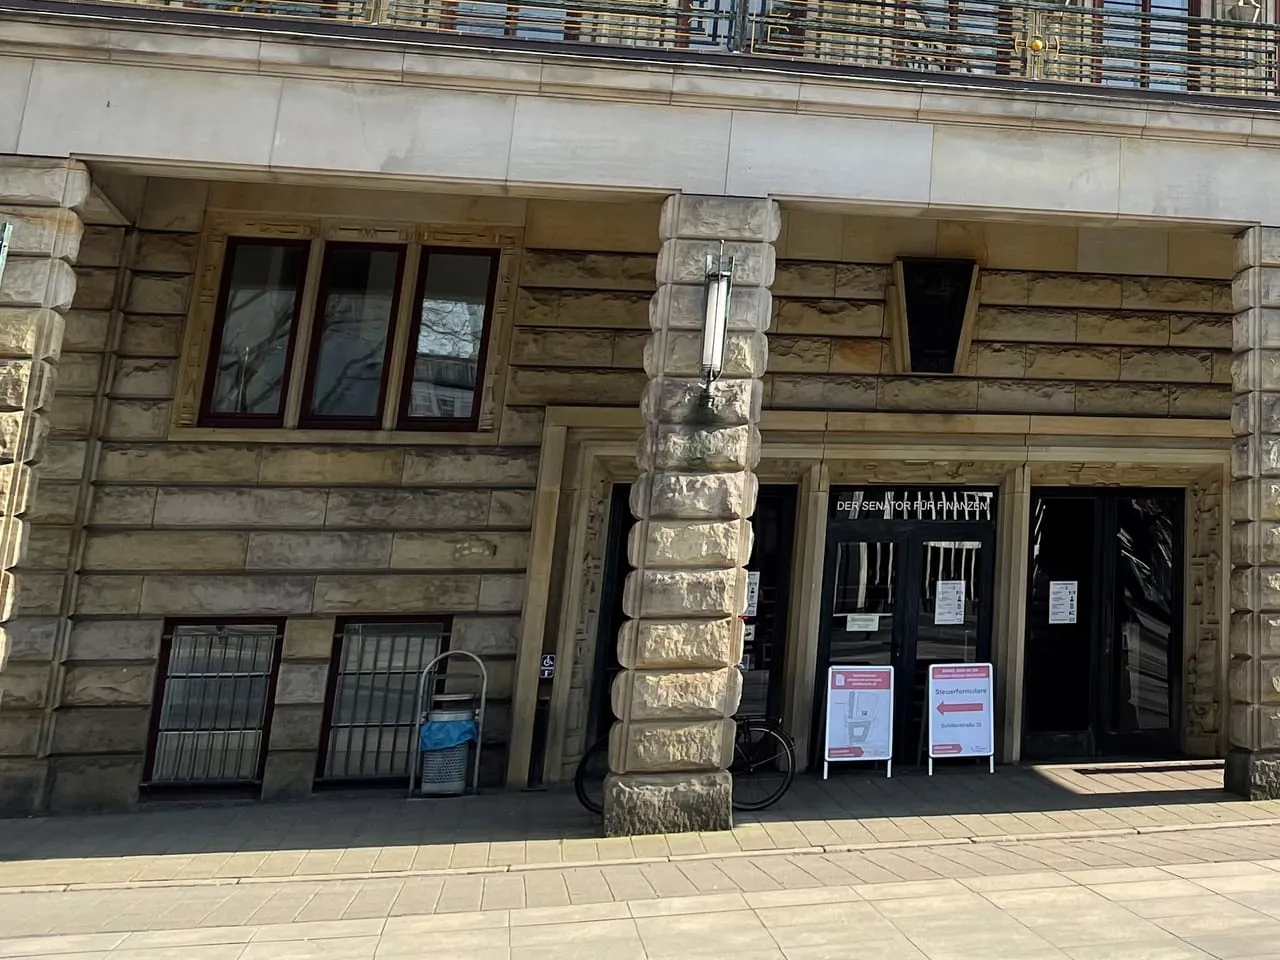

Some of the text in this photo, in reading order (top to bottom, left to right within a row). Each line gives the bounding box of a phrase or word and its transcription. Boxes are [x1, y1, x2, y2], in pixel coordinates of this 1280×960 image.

[837, 499, 988, 511] DER SENATOR FÜR FINANZEN
